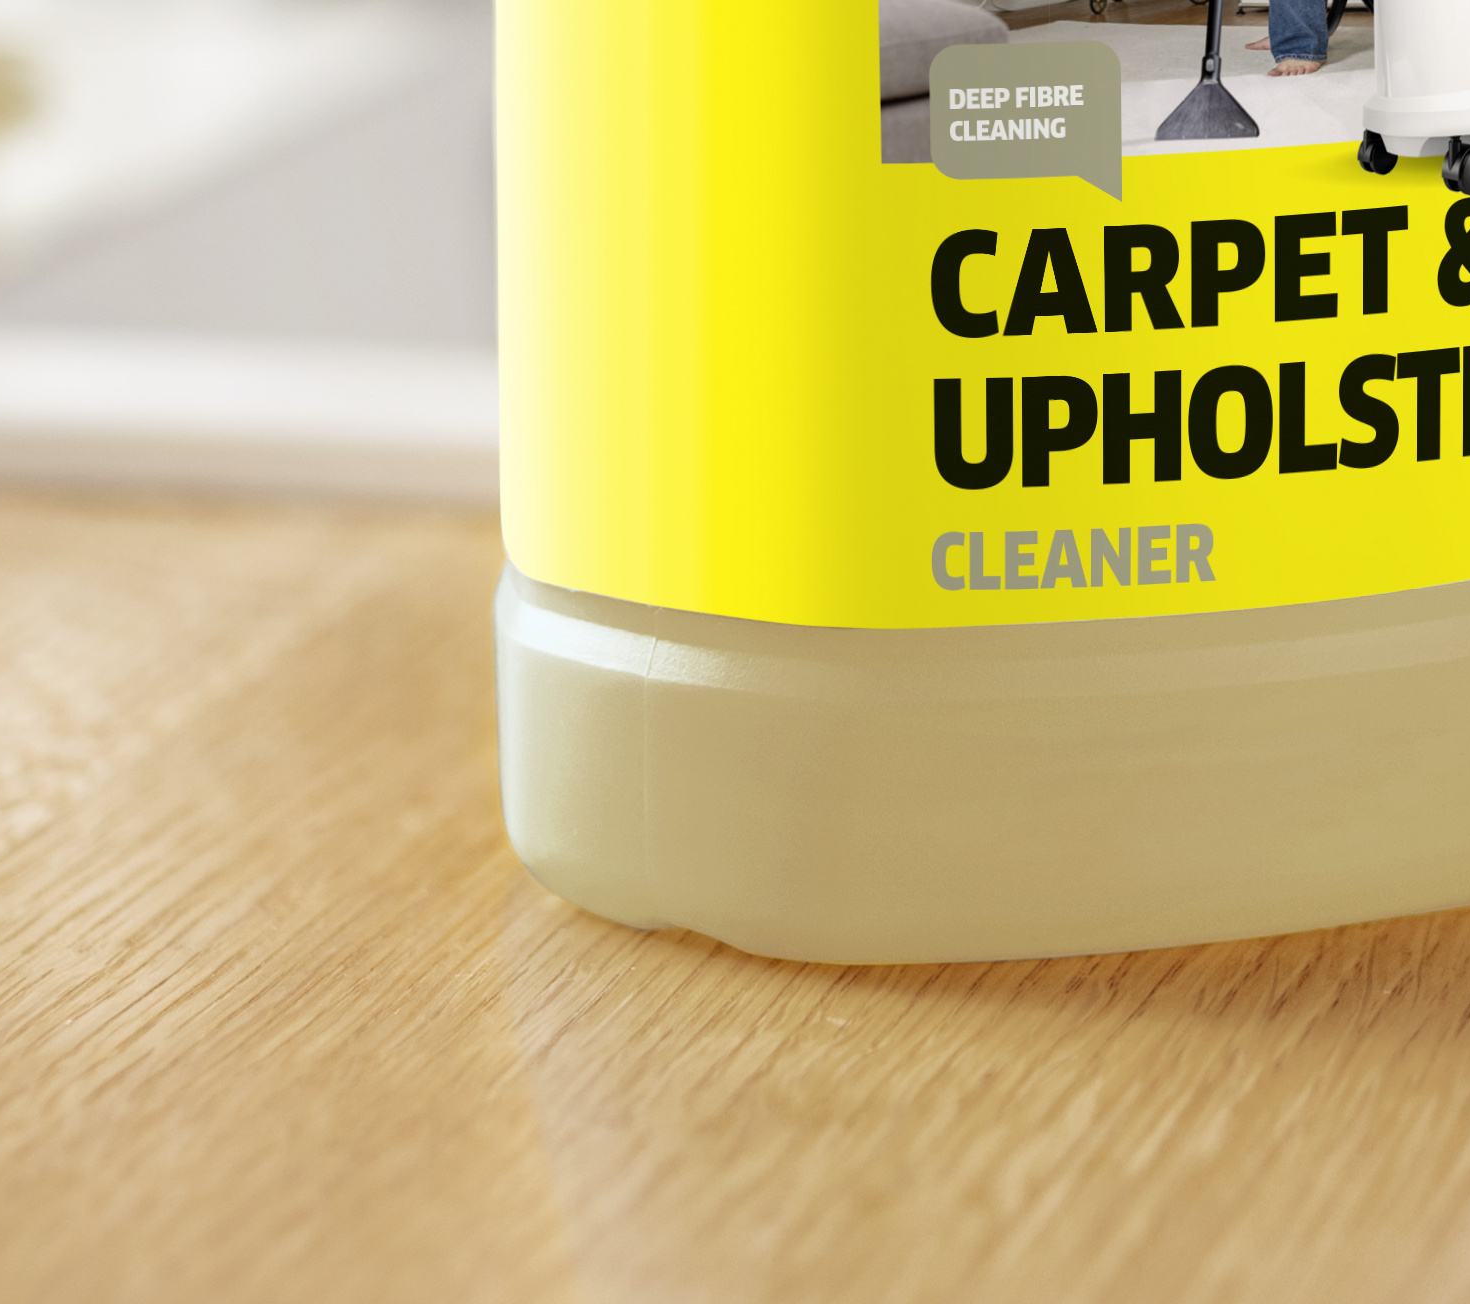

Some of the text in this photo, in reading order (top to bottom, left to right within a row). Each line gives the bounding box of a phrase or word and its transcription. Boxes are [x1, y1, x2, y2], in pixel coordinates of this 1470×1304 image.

[948, 84, 1085, 110] DEEP FIBRE
[949, 117, 1067, 142] CLEANING
[930, 204, 1409, 339] CARPET
[931, 522, 1216, 592] CLEANER
